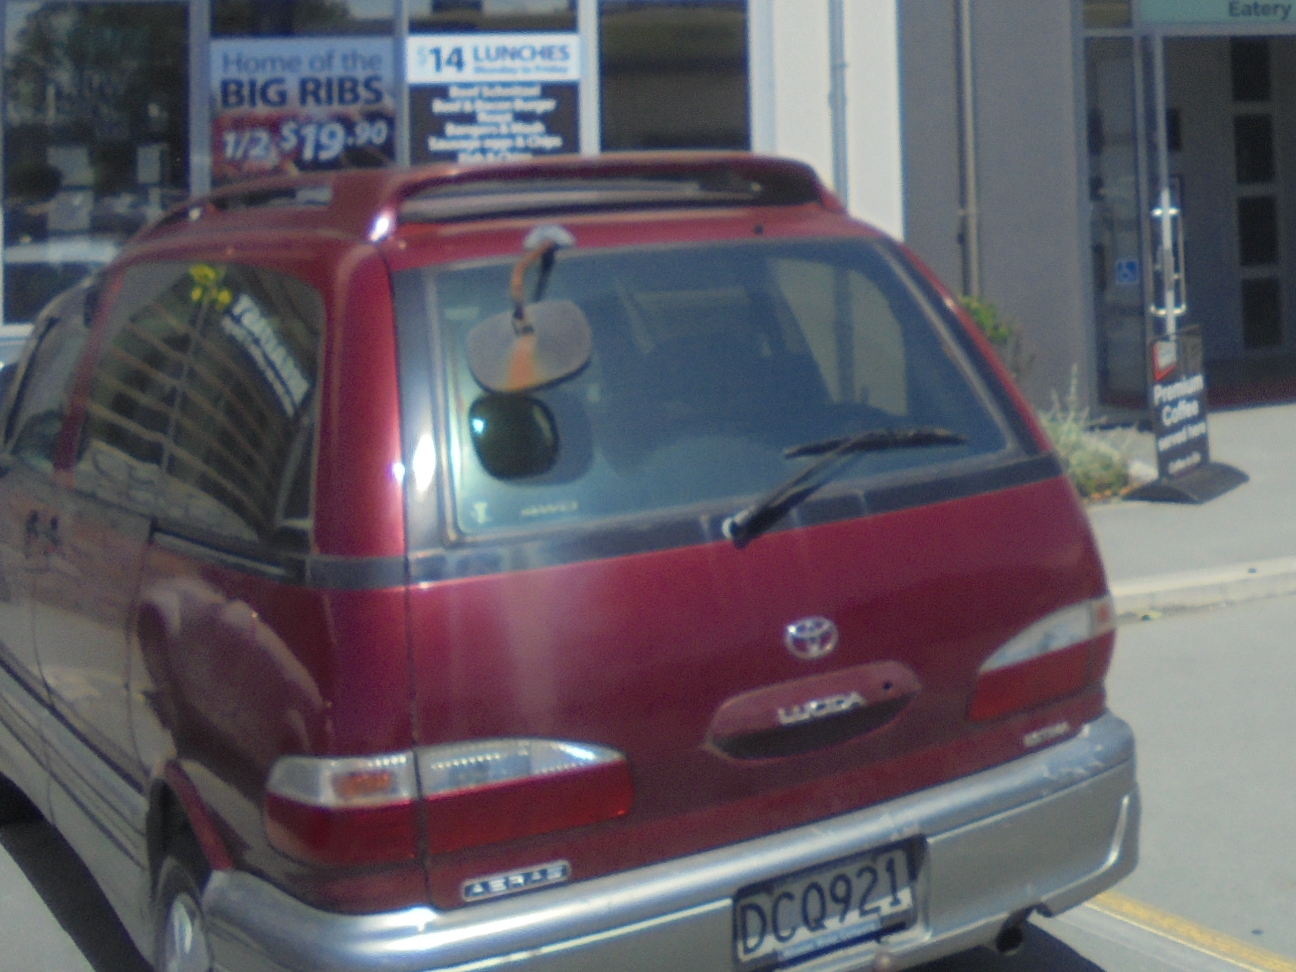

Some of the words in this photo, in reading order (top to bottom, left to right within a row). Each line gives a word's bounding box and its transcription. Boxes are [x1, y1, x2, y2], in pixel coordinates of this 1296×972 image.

[1228, 1, 1292, 20] Eatery
[222, 51, 300, 73] Home
[308, 48, 336, 72] of
[341, 49, 383, 72] the
[473, 44, 571, 62] LUNCHES
[220, 78, 289, 108] BIG
[299, 74, 384, 106] RIBS
[223, 130, 271, 160] 1/2
[279, 117, 389, 163] $19.90
[1153, 374, 1204, 405] Premium
[1162, 399, 1199, 427] Coffee
[740, 856, 903, 955] DCQ921
